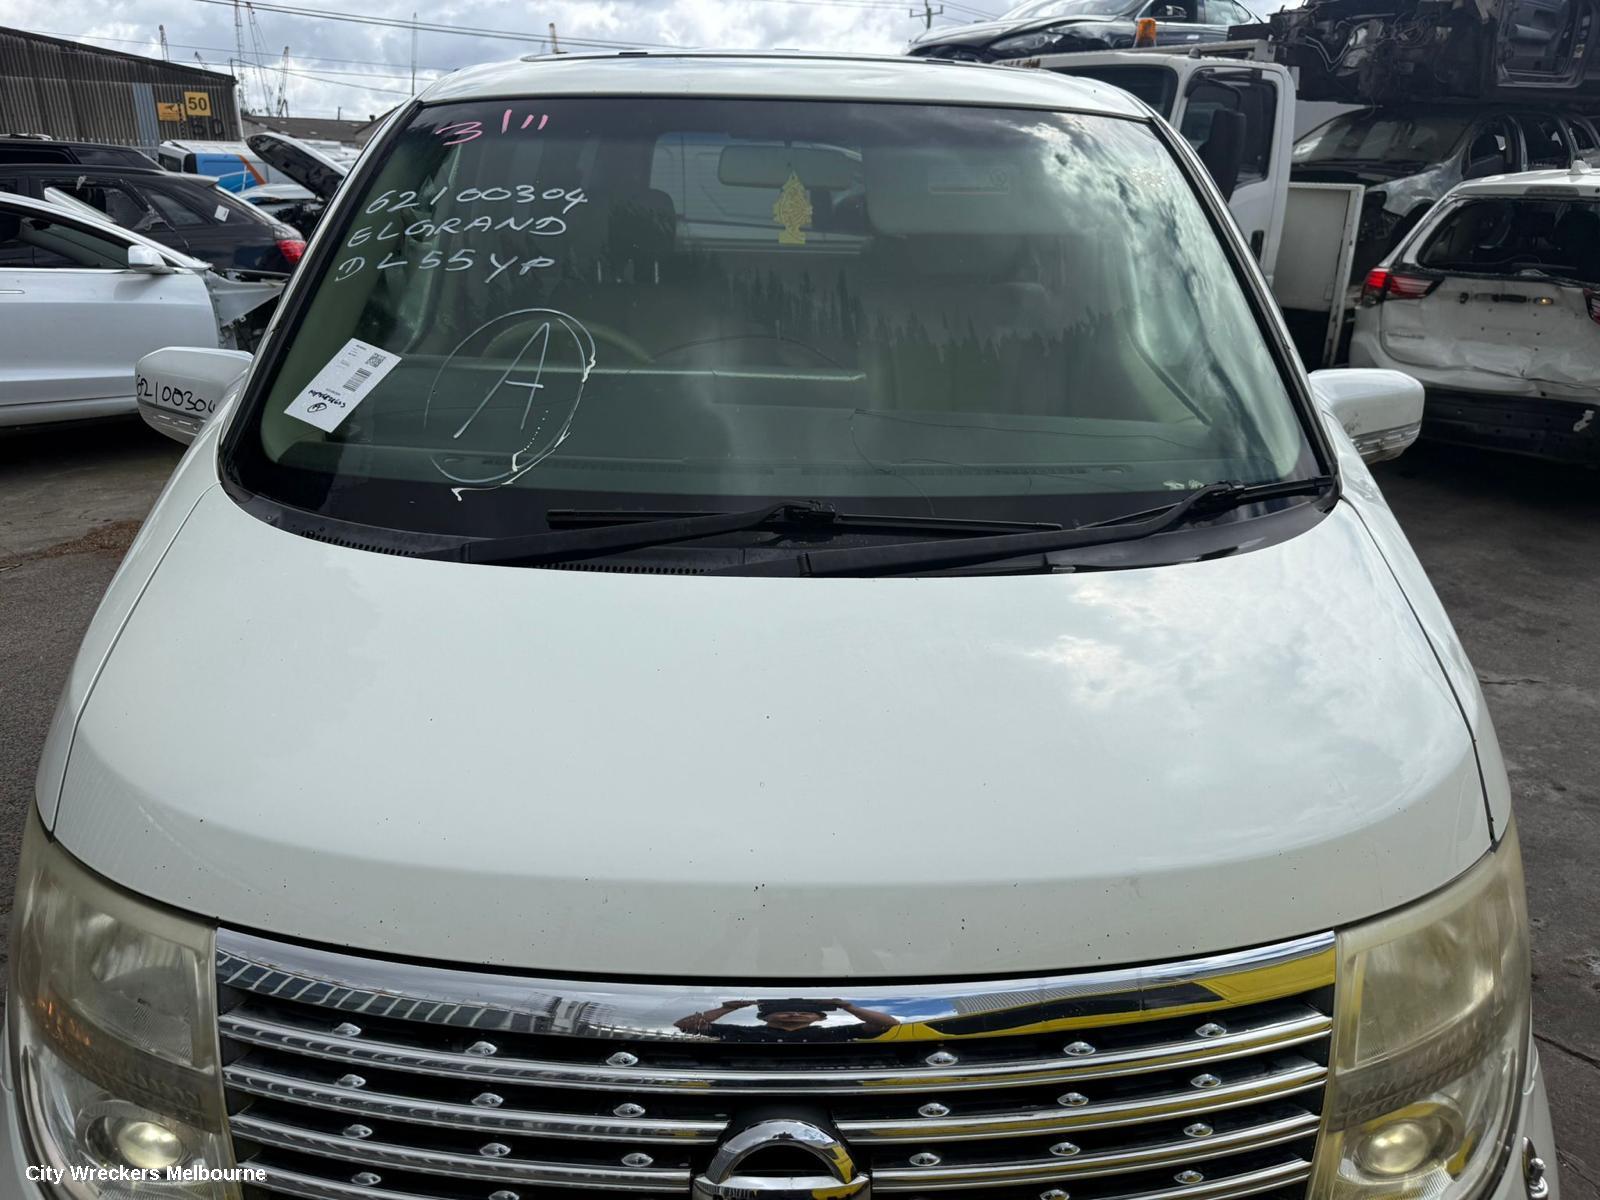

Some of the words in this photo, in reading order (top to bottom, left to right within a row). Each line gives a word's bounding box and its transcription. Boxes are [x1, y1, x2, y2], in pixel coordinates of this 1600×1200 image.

[188, 97, 207, 111] 50
[366, 185, 588, 214] 62100304
[347, 216, 567, 247] ELGRAND
